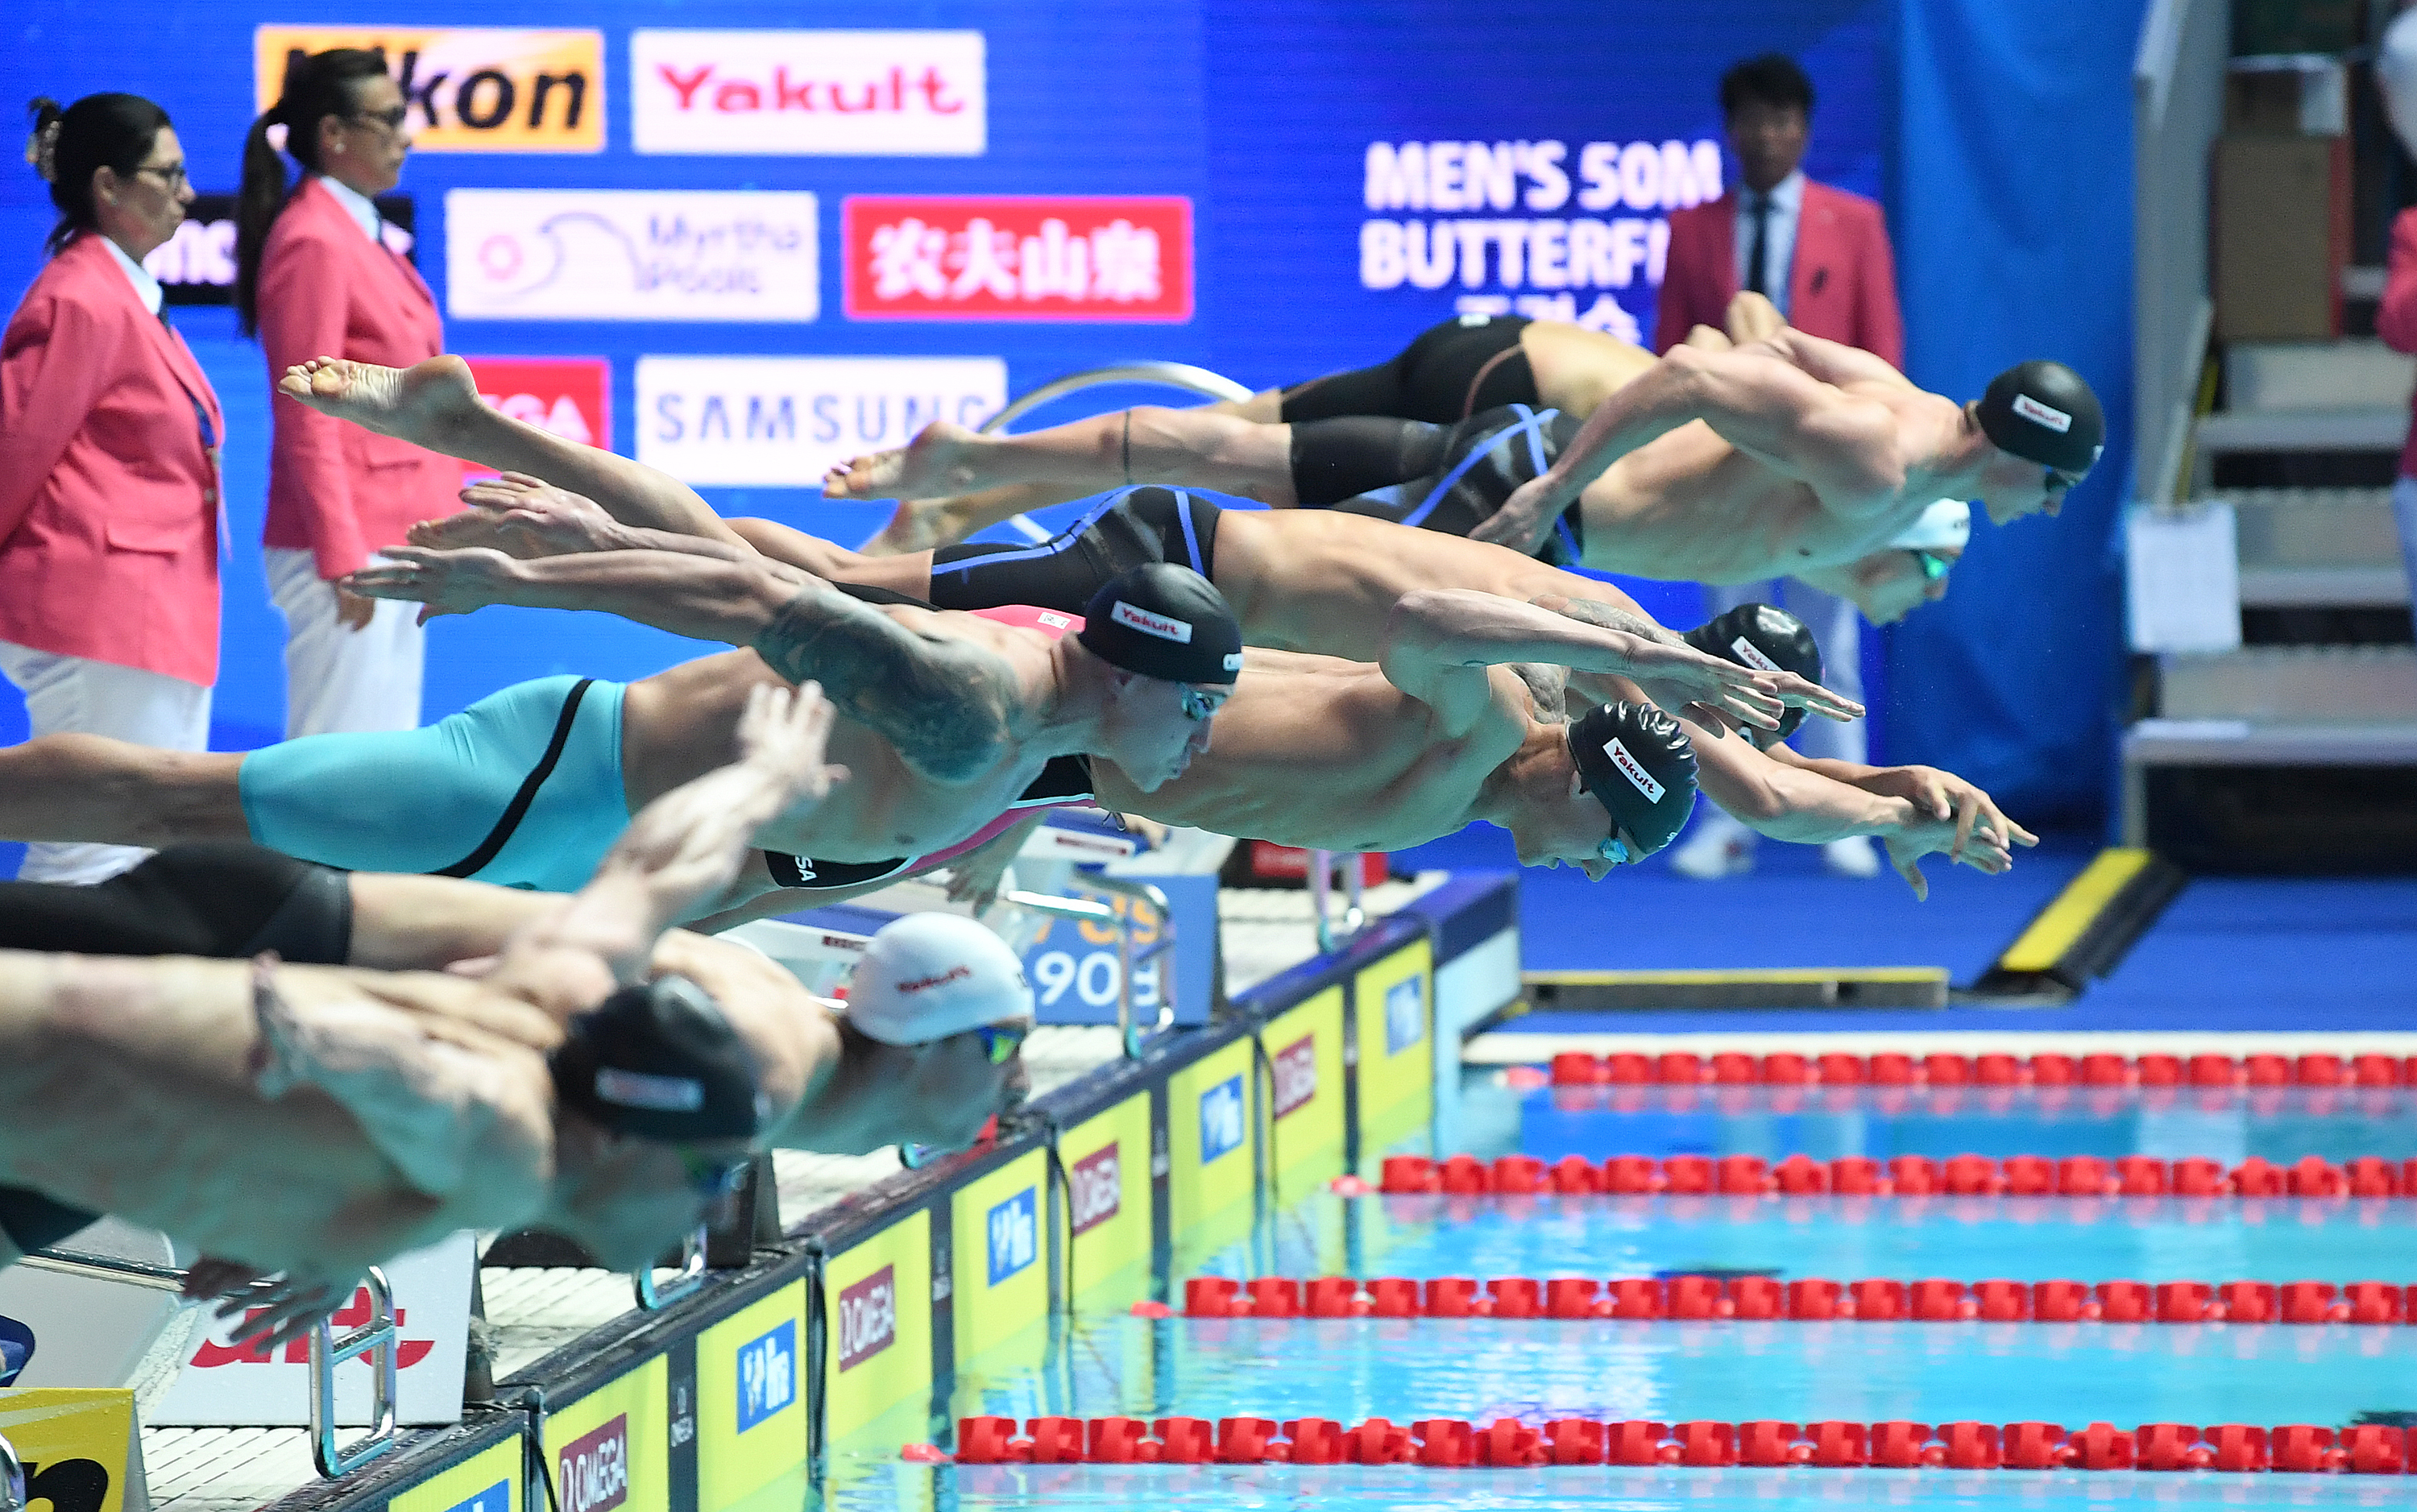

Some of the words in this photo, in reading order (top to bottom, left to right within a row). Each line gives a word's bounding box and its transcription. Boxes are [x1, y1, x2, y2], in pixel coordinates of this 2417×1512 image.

[287, 48, 589, 133] kon
[657, 64, 965, 116] Yakult
[1364, 139, 1571, 213] MEN'S
[1577, 137, 1723, 213] 50M
[649, 213, 801, 260] Myrtha
[869, 217, 1162, 303] 农夫山泉
[1122, 607, 1179, 636] Yakult
[1613, 745, 1655, 794] Yakult
[794, 855, 819, 882] SA
